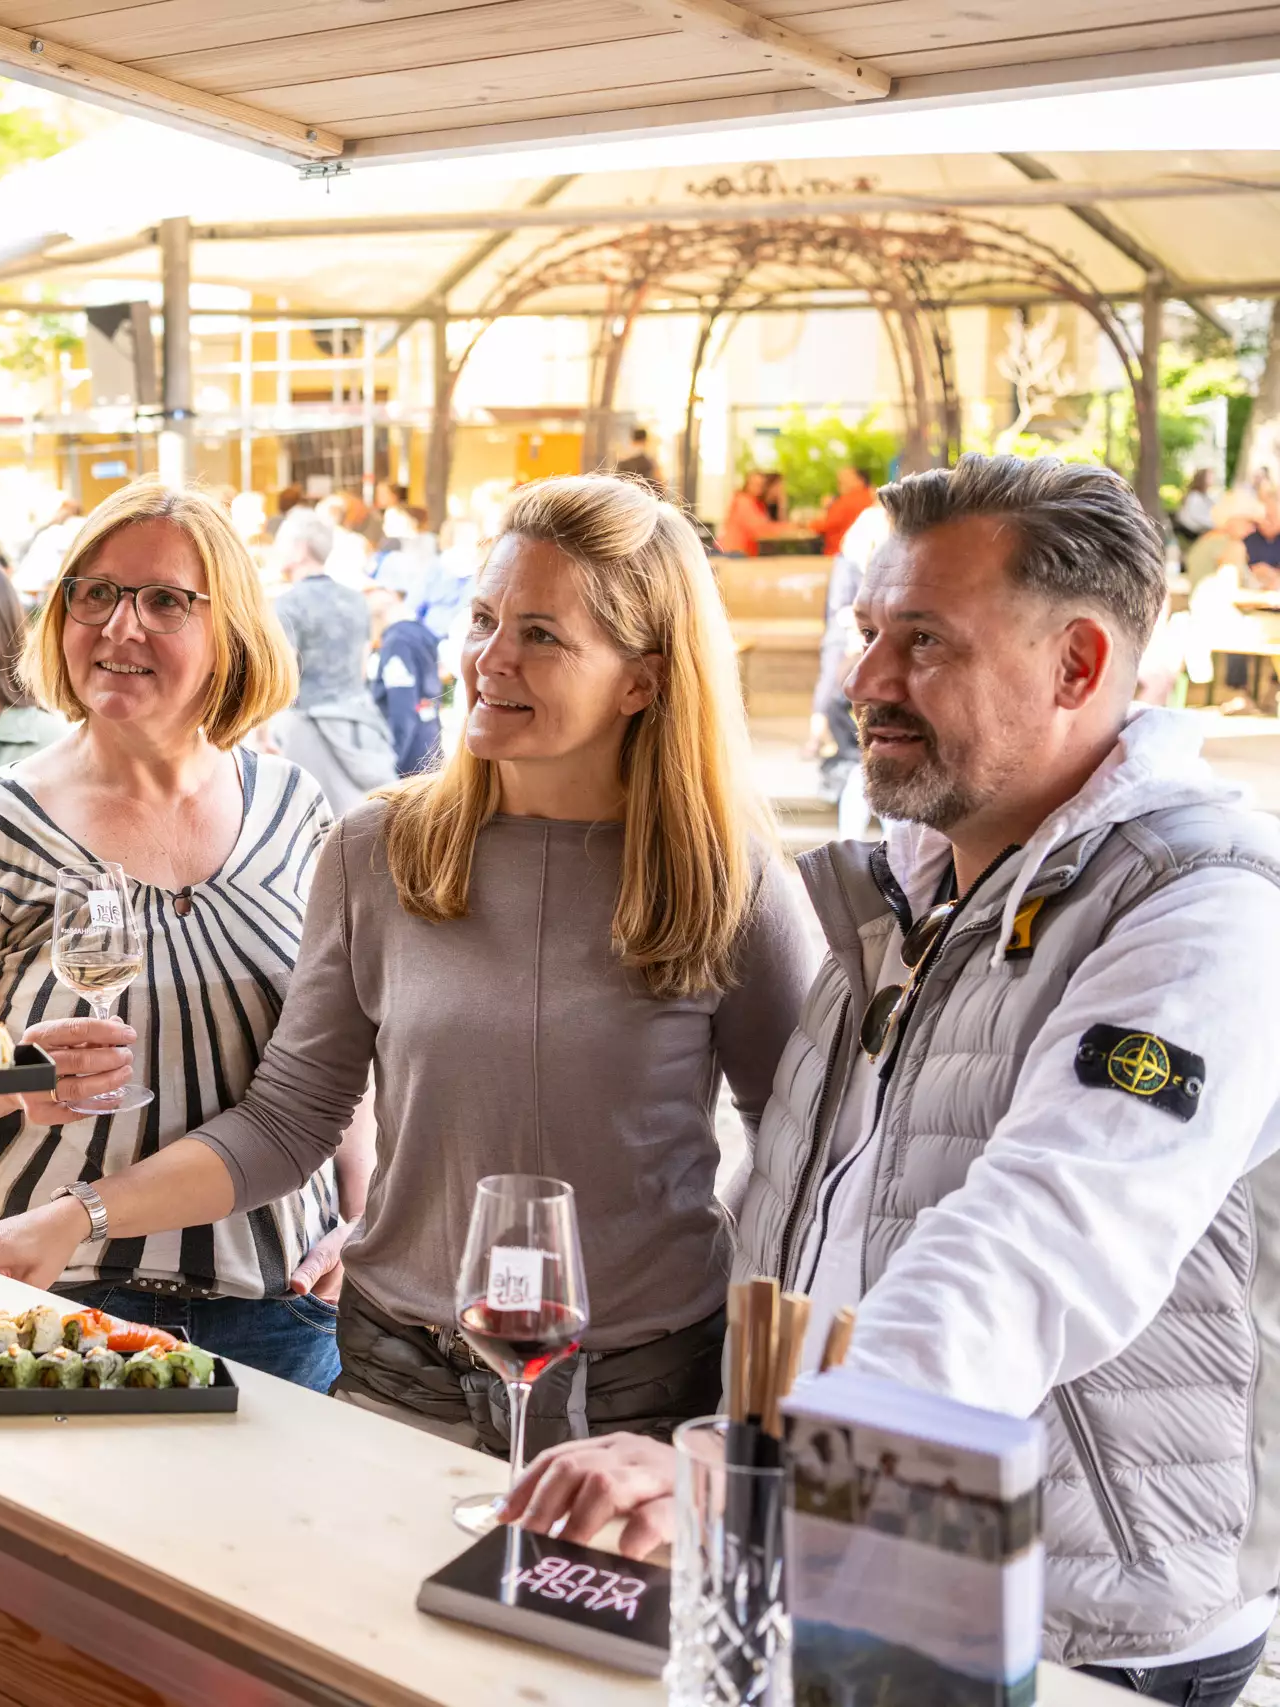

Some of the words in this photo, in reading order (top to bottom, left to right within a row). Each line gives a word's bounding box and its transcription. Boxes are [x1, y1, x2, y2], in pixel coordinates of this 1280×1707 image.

[493, 1266, 527, 1297] ahr
[501, 1566, 639, 1621] WUSH
[533, 1556, 648, 1599] CLUB
